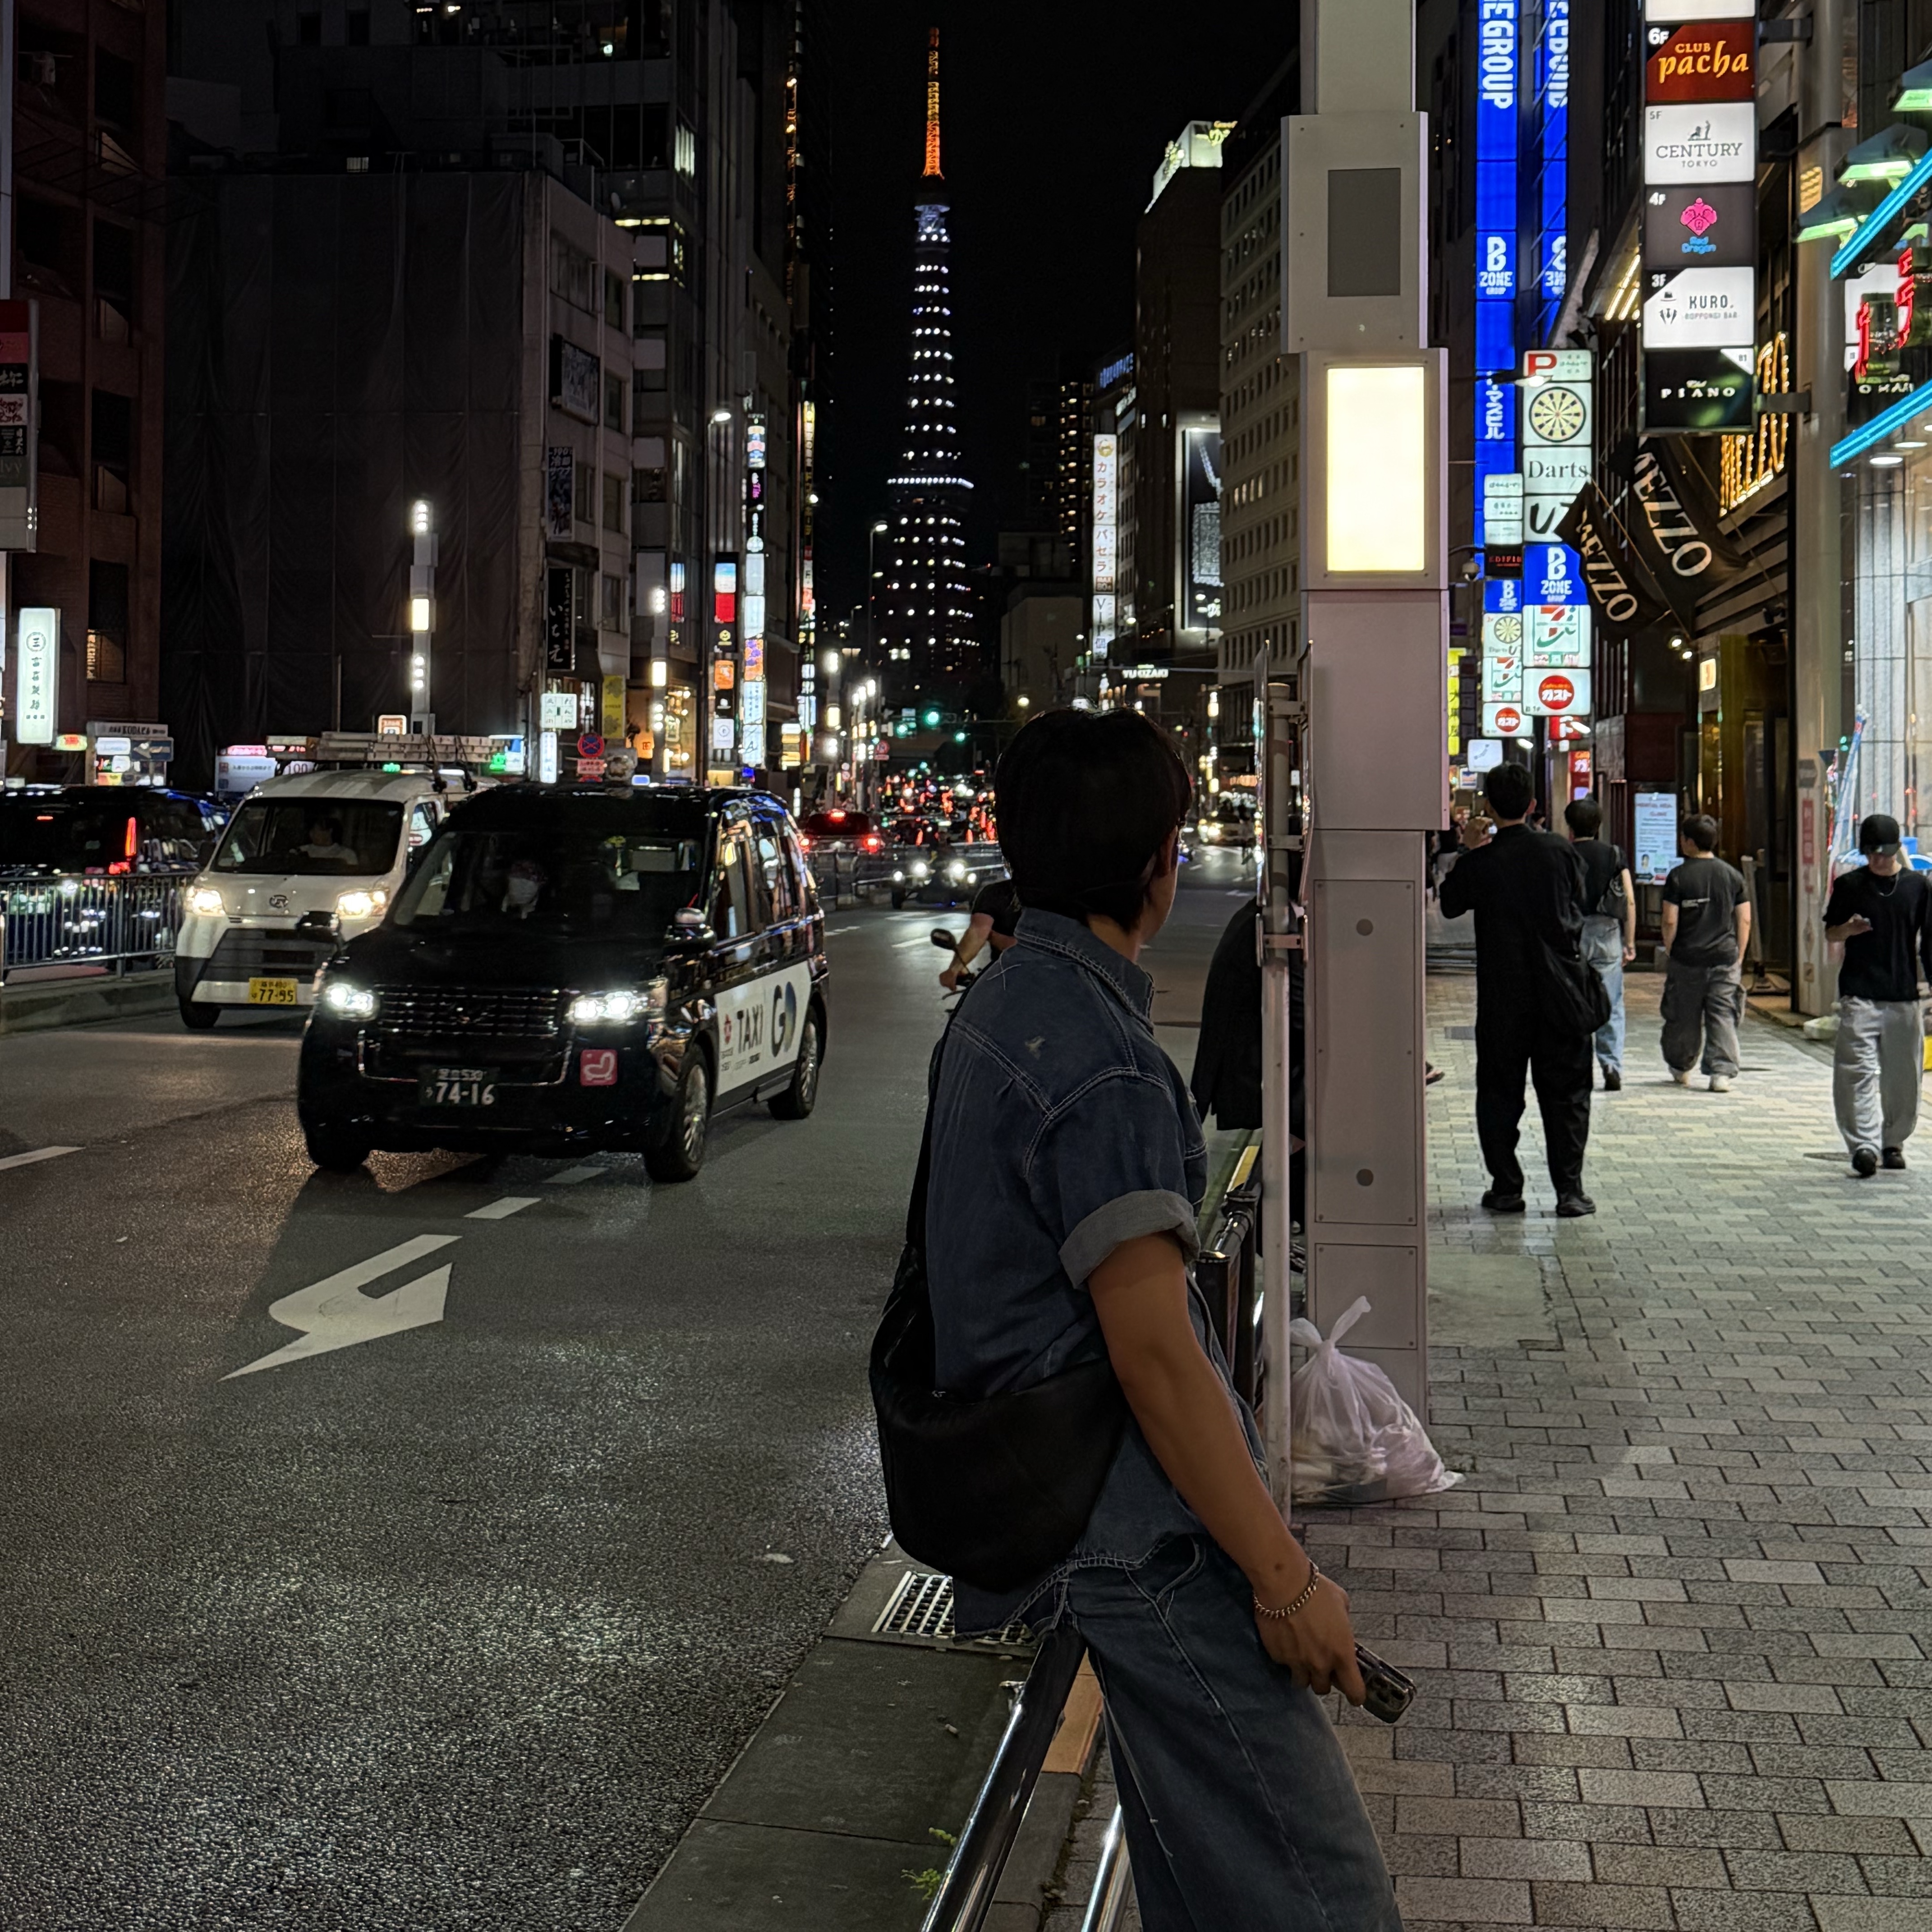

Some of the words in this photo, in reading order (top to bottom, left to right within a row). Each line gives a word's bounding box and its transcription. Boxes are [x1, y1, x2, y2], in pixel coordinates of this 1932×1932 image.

[1648, 28, 1669, 44] 6F
[1675, 43, 1711, 53] CLUB
[1658, 41, 1749, 83] pacha
[1650, 110, 1662, 120] 5F
[1656, 143, 1743, 158] CENTURY
[1682, 160, 1717, 168] TOKYO
[1649, 192, 1666, 205] 4F
[1487, 237, 1506, 271] B
[1479, 271, 1513, 287] ZONE
[1651, 274, 1666, 287] 3F
[1724, 311, 1737, 319] BAR
[1527, 353, 1557, 377] P
[1661, 387, 1736, 399] PIANO
[1528, 460, 1587, 478] Darts
[1097, 461, 1107, 520] カラオケ
[1547, 547, 1566, 580] B
[1541, 580, 1573, 595] ZONE
[771, 981, 797, 1058] GO
[736, 1003, 763, 1054] TAXI
[435, 1081, 495, 1105] 74-16
